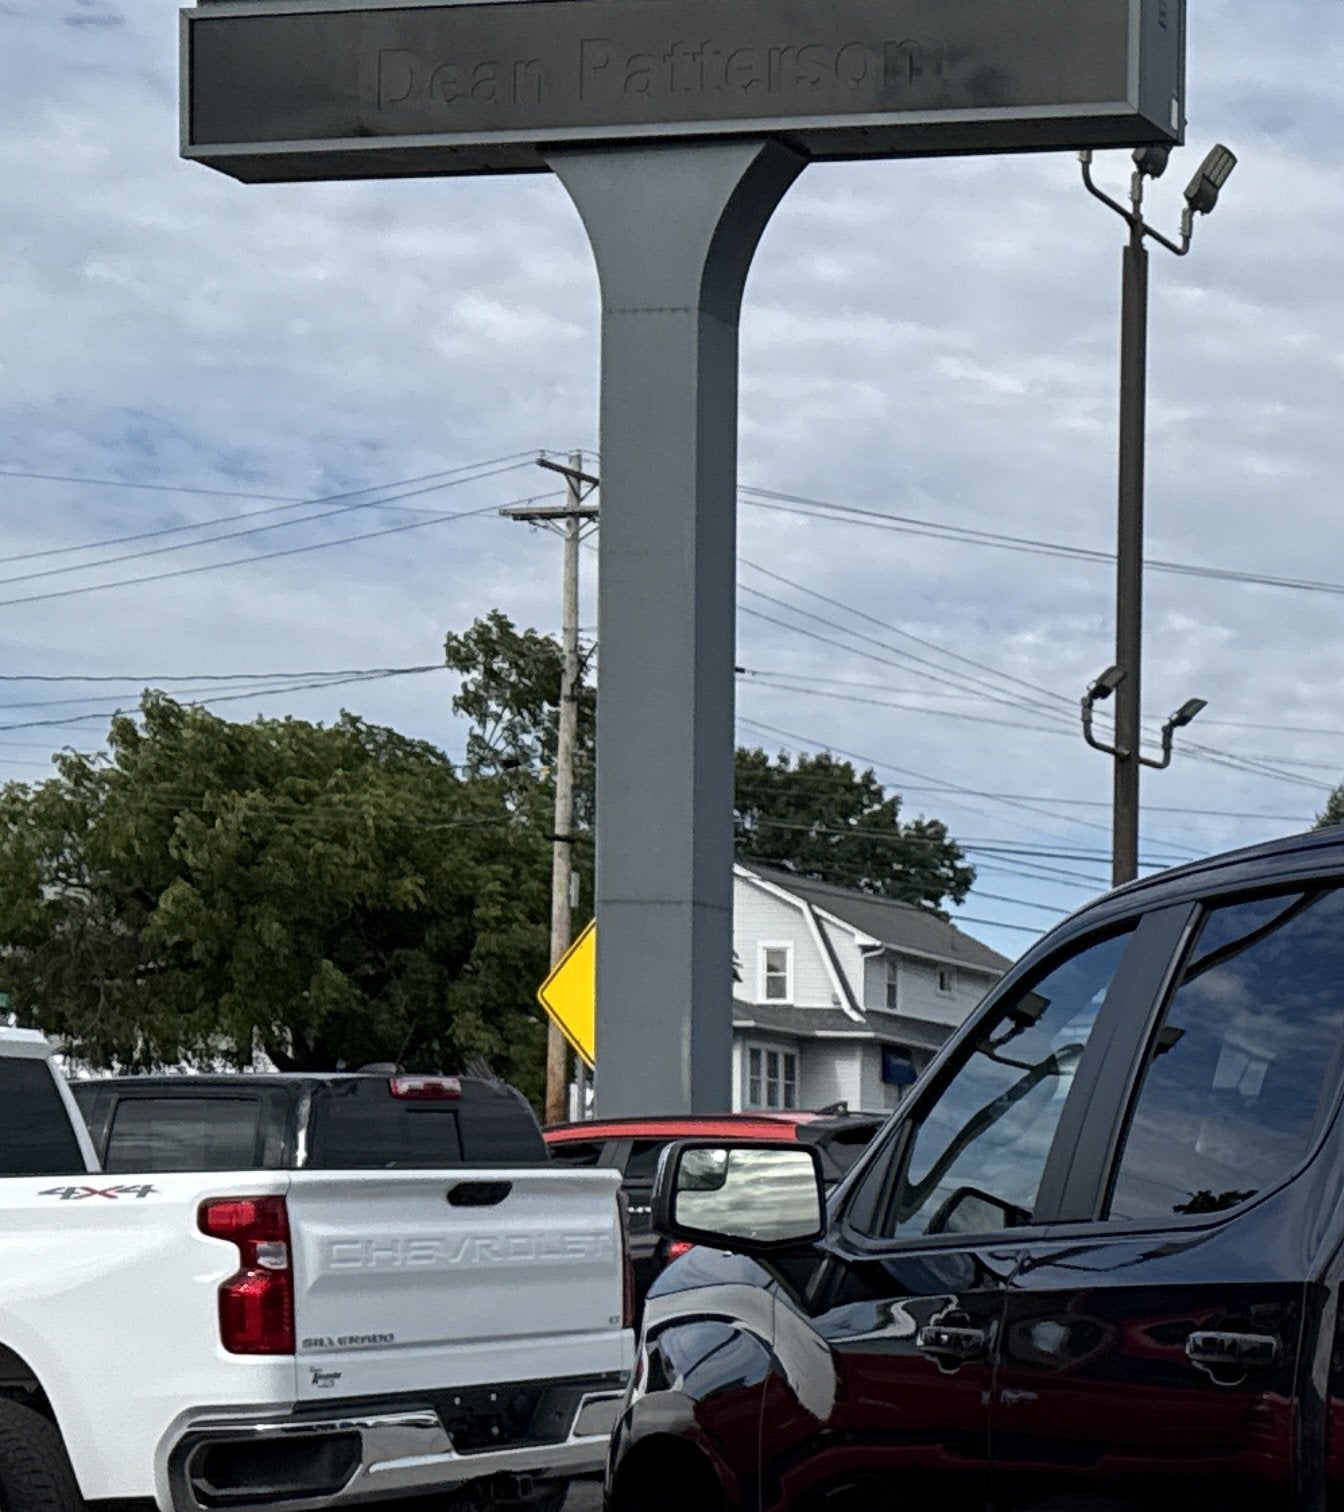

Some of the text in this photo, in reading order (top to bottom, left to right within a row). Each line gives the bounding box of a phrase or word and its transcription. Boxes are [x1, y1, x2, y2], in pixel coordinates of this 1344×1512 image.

[377, 37, 920, 111] Dean Patterson
[328, 1233, 612, 1268] CHEVROLET
